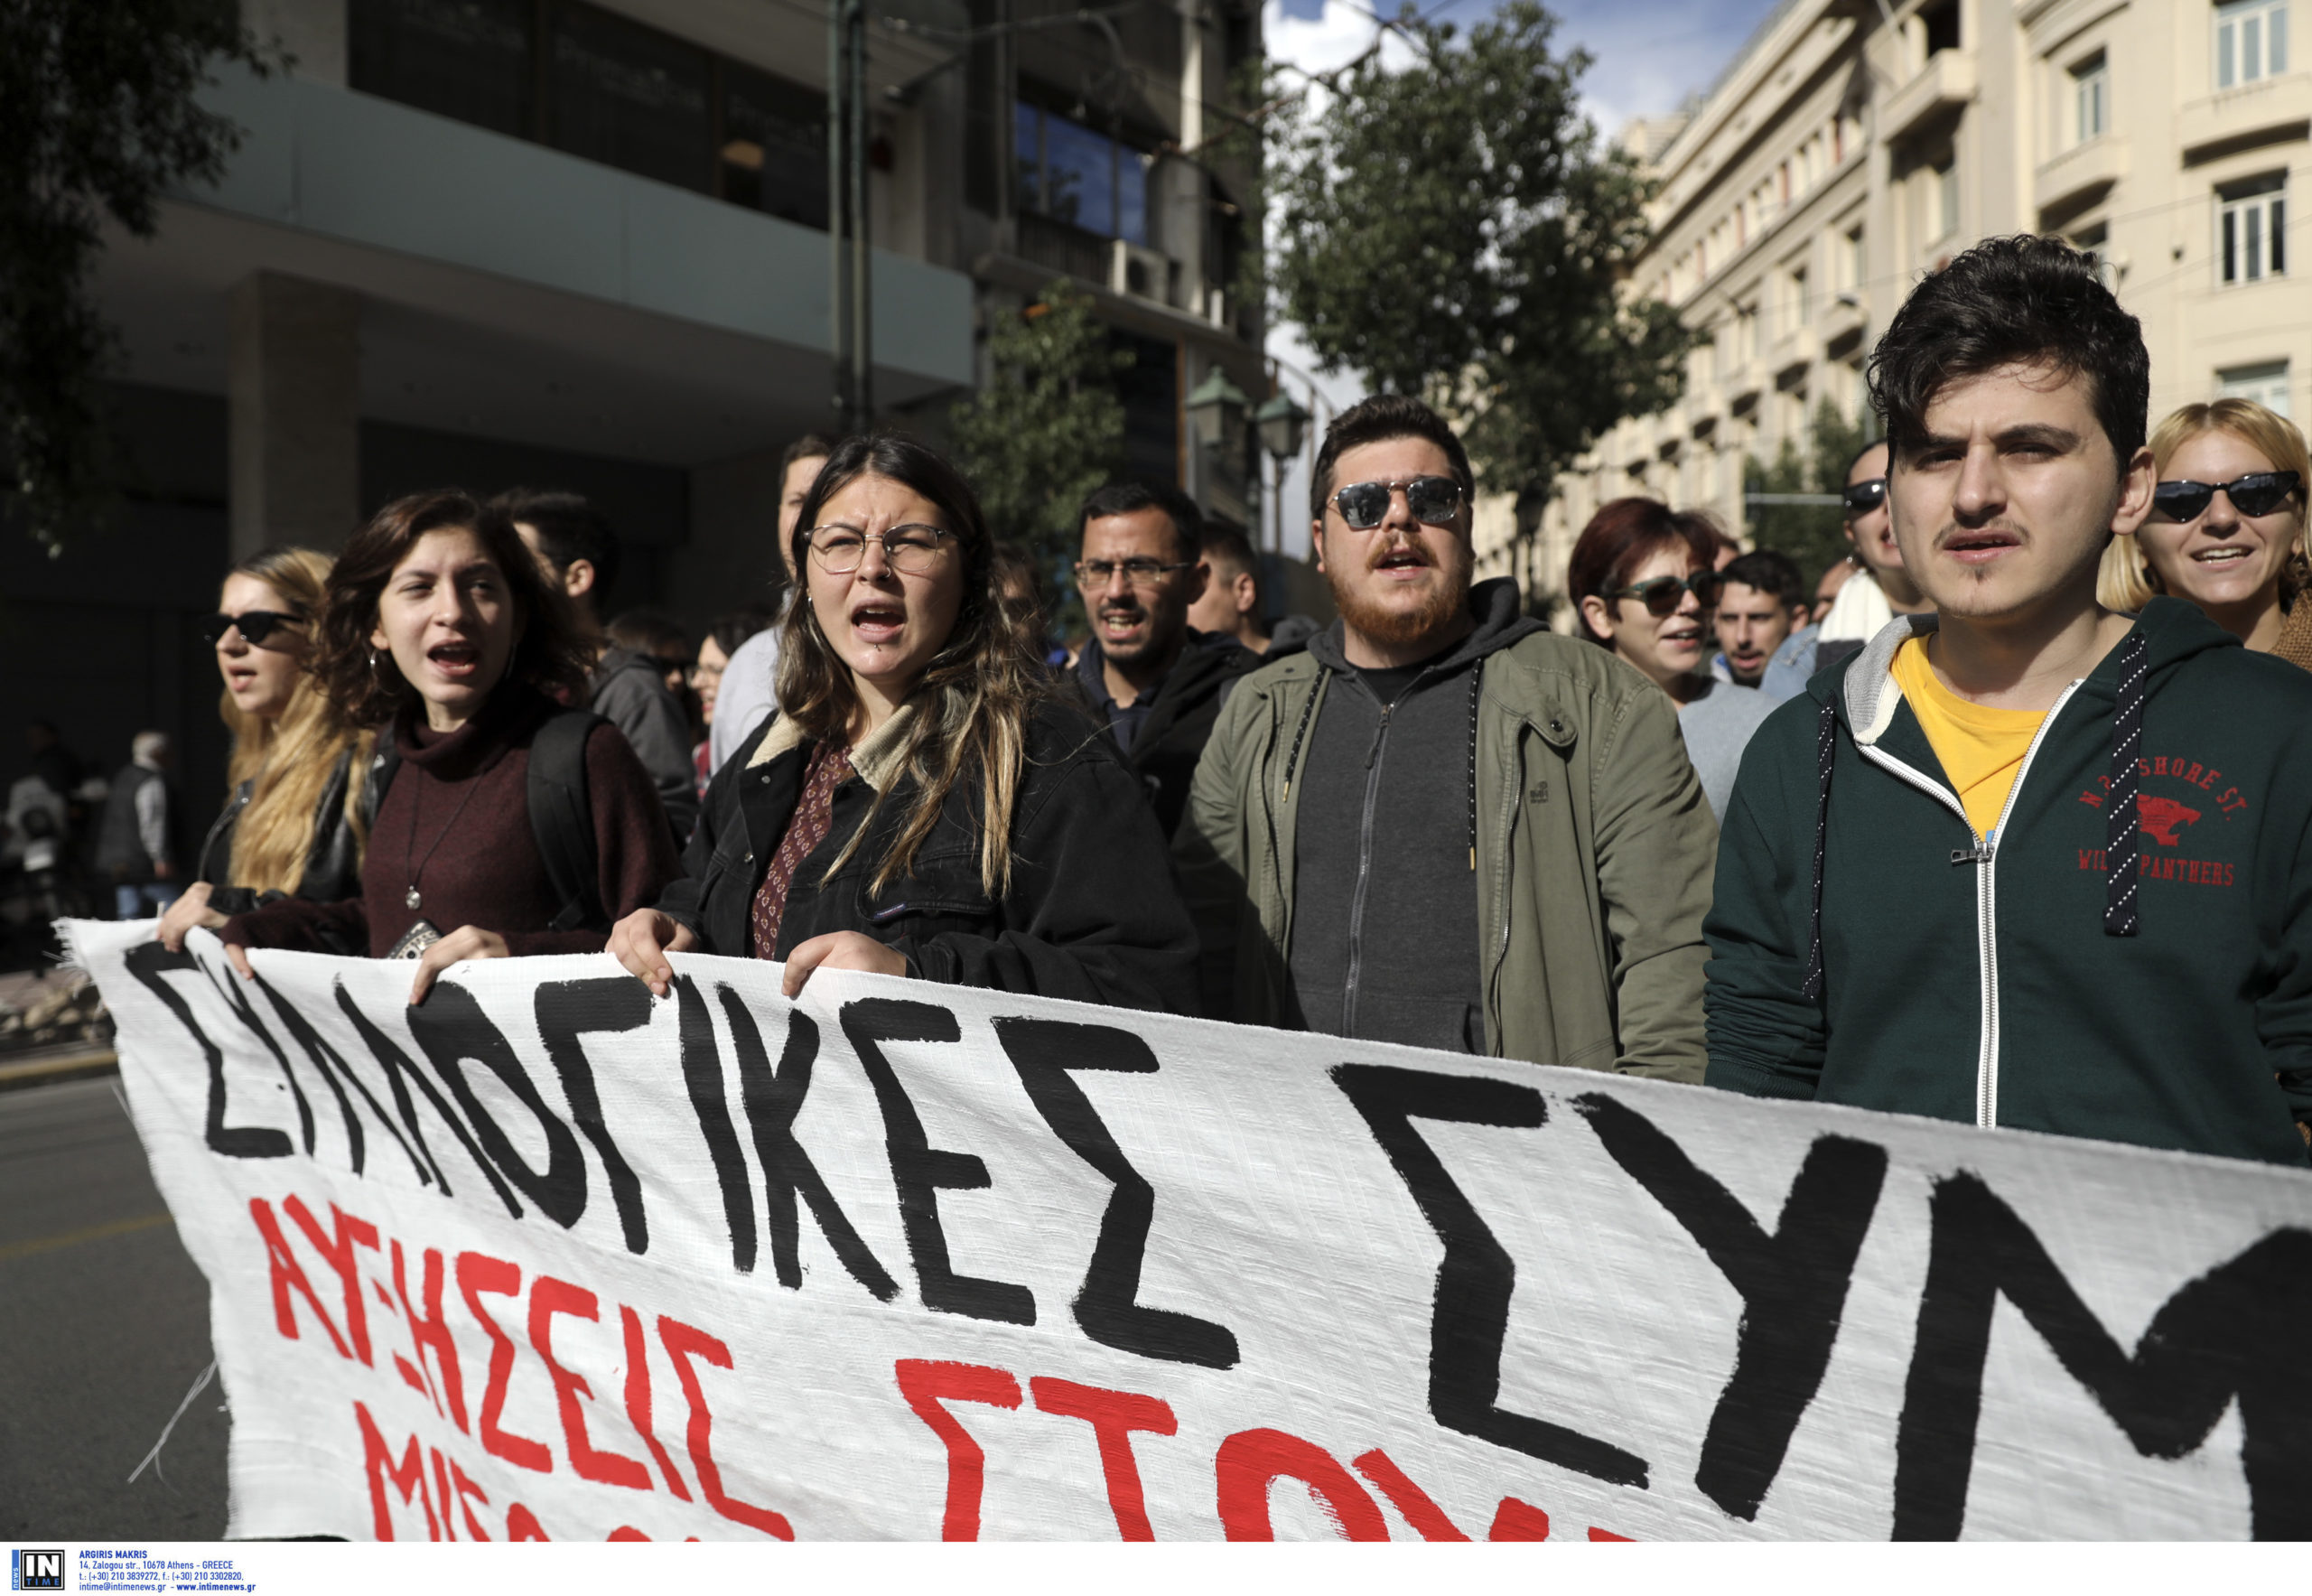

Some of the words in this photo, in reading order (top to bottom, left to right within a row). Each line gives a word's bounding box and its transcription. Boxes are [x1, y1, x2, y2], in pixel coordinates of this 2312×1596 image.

[2138, 756, 2222, 790] SHORE
[2216, 787, 2248, 821] ST.
[2078, 849, 2109, 871] WIL
[2139, 854, 2234, 887] PANTHERS
